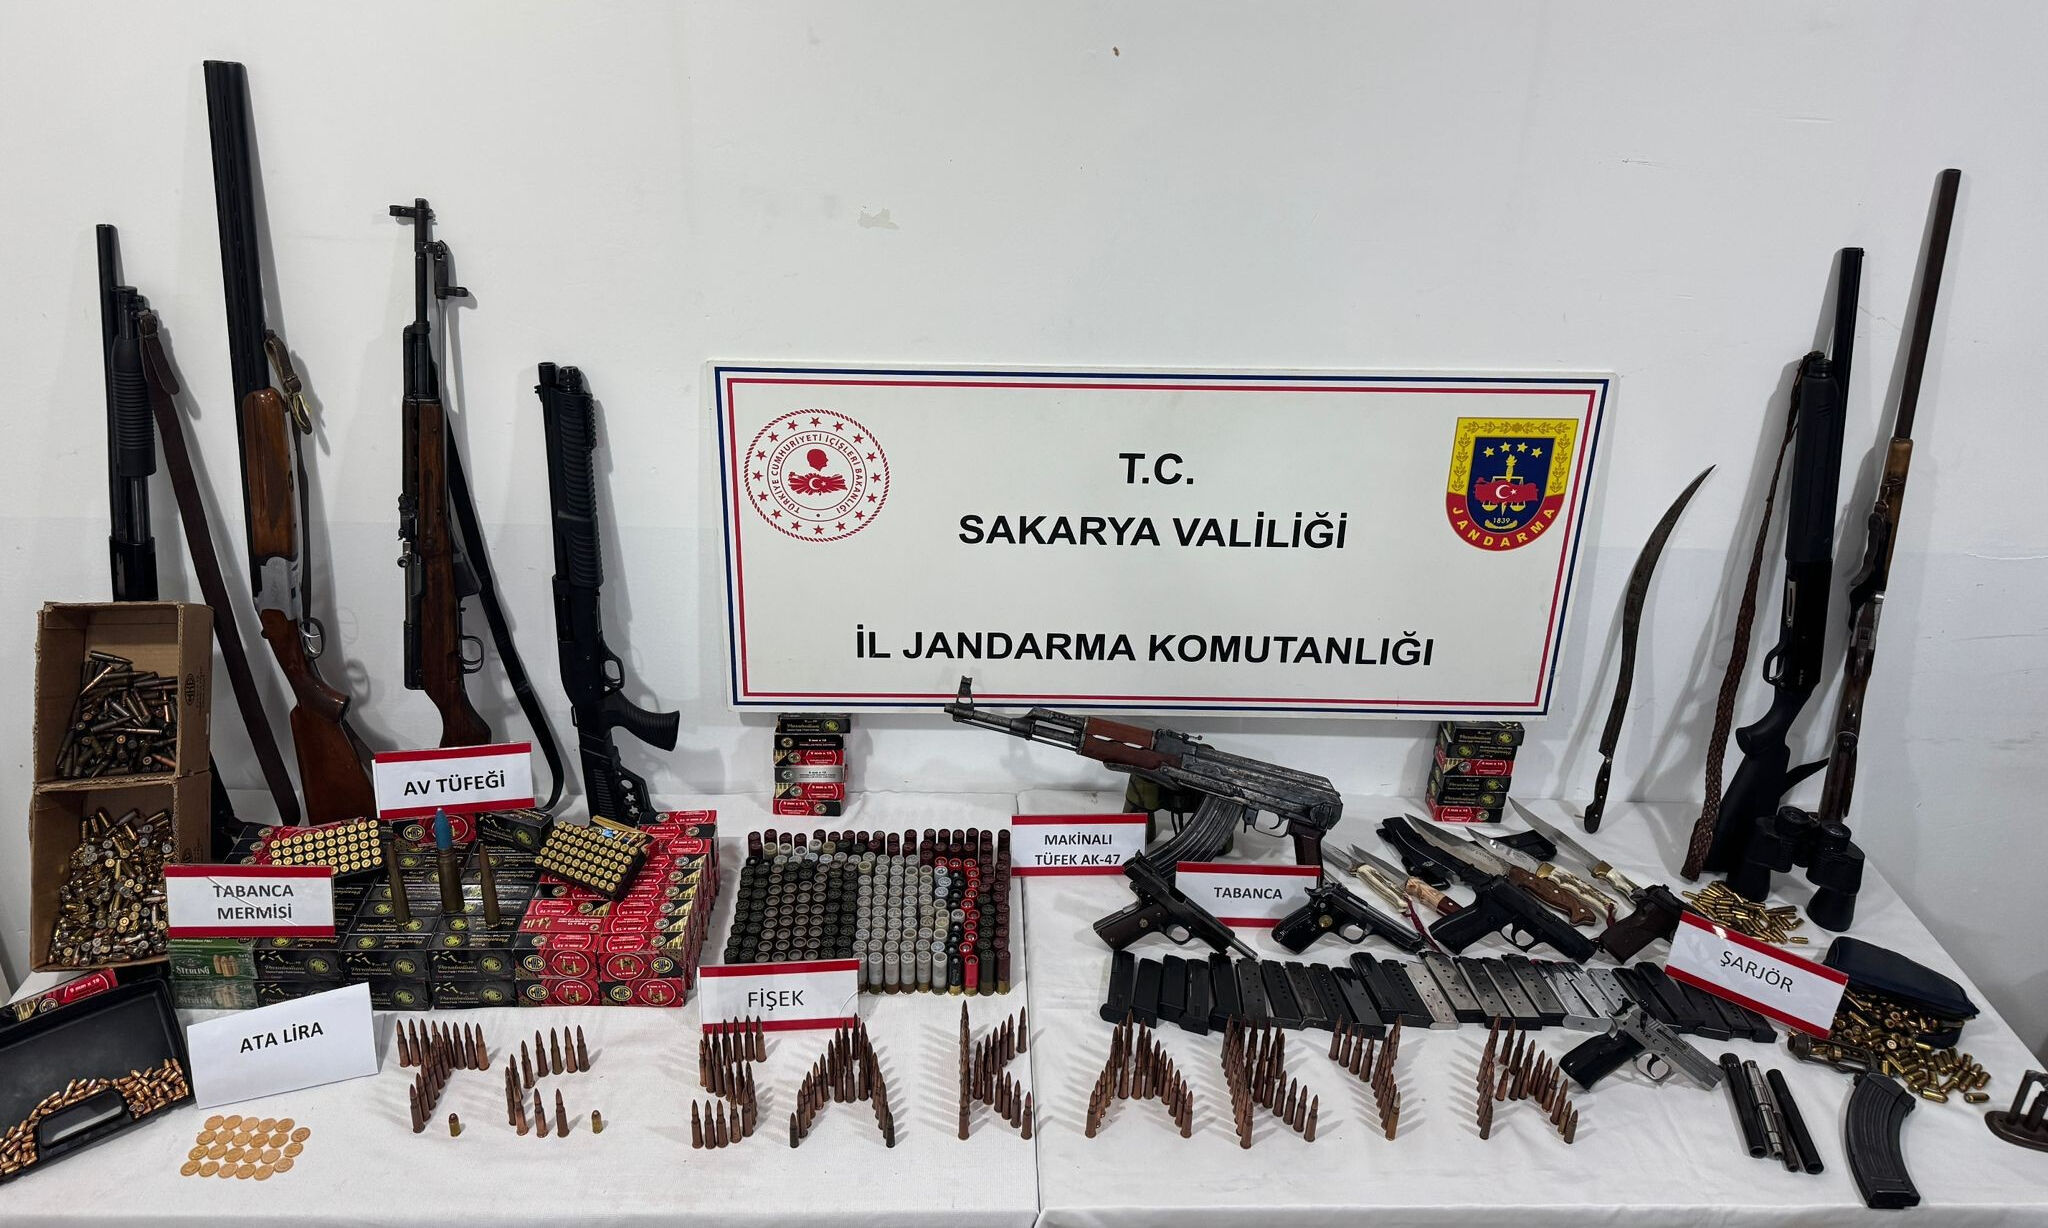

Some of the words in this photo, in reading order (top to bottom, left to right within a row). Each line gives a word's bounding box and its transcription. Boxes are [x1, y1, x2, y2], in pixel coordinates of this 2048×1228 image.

[771, 433, 822, 476] CUMHURİYETİ
[825, 434, 860, 466] İÇİŞLERİ
[1119, 453, 1194, 484] T.C.
[771, 479, 800, 514] TÜRKİYE
[836, 468, 864, 514] BAKANLIĞI
[959, 515, 1160, 546] SAKARYA
[1173, 512, 1348, 548] VALİLİĞİ
[1452, 507, 1555, 547] JANDARMA
[857, 624, 890, 658] İL
[903, 632, 1136, 662] JANDARMA
[1149, 631, 1434, 666] KOMUTANLIĞI
[404, 780, 431, 796] AV
[436, 770, 505, 793] TÜFEĞİ
[1044, 832, 1112, 845] MAKİNALI
[1035, 852, 1077, 865] TÜFEK
[1081, 854, 1121, 865] AK-47
[212, 884, 294, 898] TABANCA
[1214, 887, 1282, 900] TABANCA
[217, 903, 293, 920] MERMİSİ
[175, 966, 210, 975] STERLING
[1720, 950, 1793, 993] ŞARJÖR
[748, 988, 804, 1011] FİŞEK
[240, 1033, 277, 1053] ATA
[284, 1022, 324, 1044] LİRA
